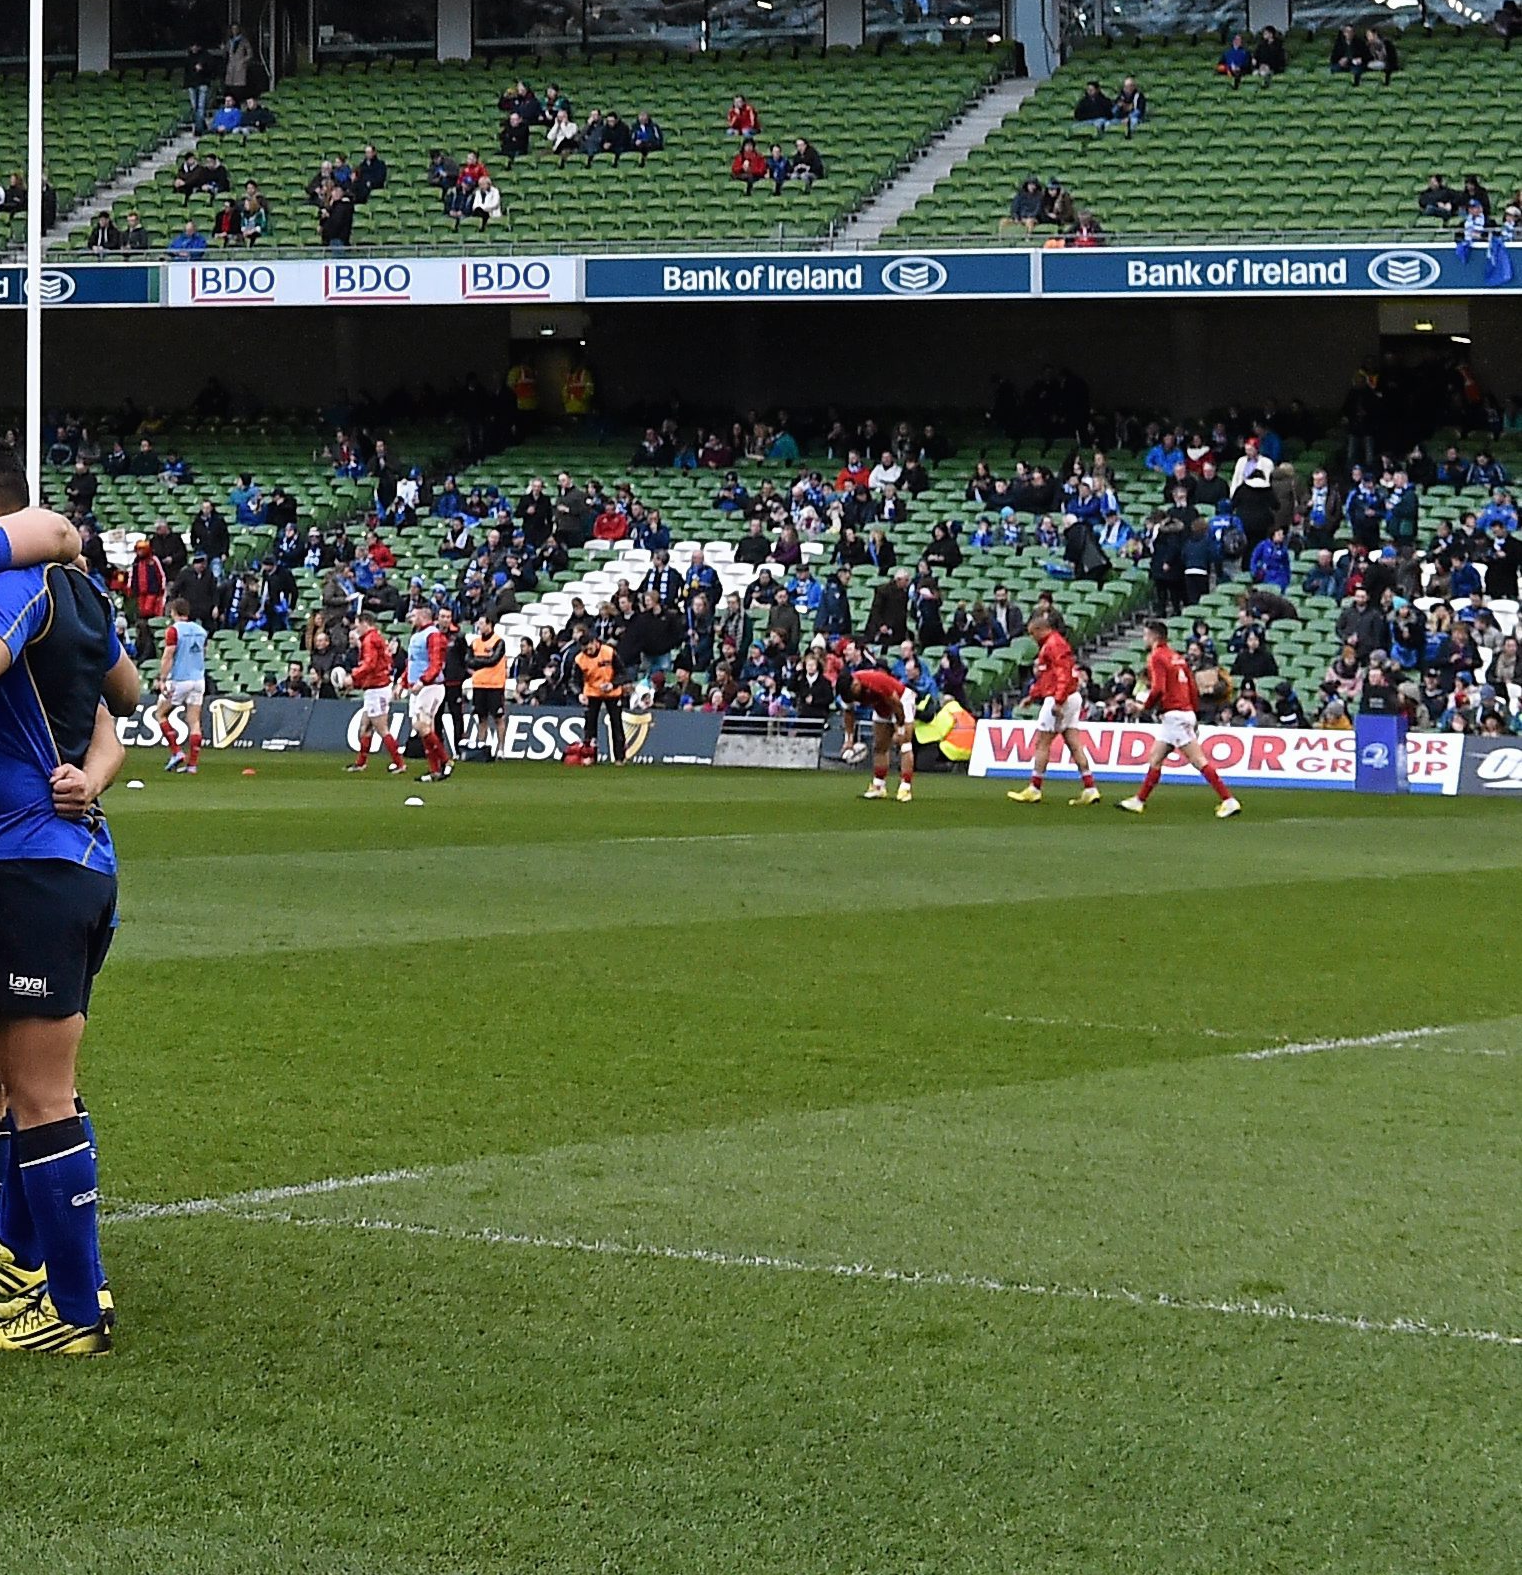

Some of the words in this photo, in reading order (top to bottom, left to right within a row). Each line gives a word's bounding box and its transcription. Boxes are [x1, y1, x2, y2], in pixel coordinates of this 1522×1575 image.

[201, 266, 276, 294] BDO
[335, 264, 411, 292] BDO
[472, 262, 551, 291] BDO
[663, 266, 732, 291] Bank
[735, 265, 766, 291] of
[768, 264, 862, 290] Ireland
[1127, 260, 1203, 286] Bank
[1206, 258, 1240, 285] of
[1243, 258, 1347, 285] Ireland
[988, 726, 1287, 771] WINDOR
[1294, 736, 1448, 755] MOOR
[1296, 757, 1448, 776] GRUP
[9, 972, 43, 991] laya
